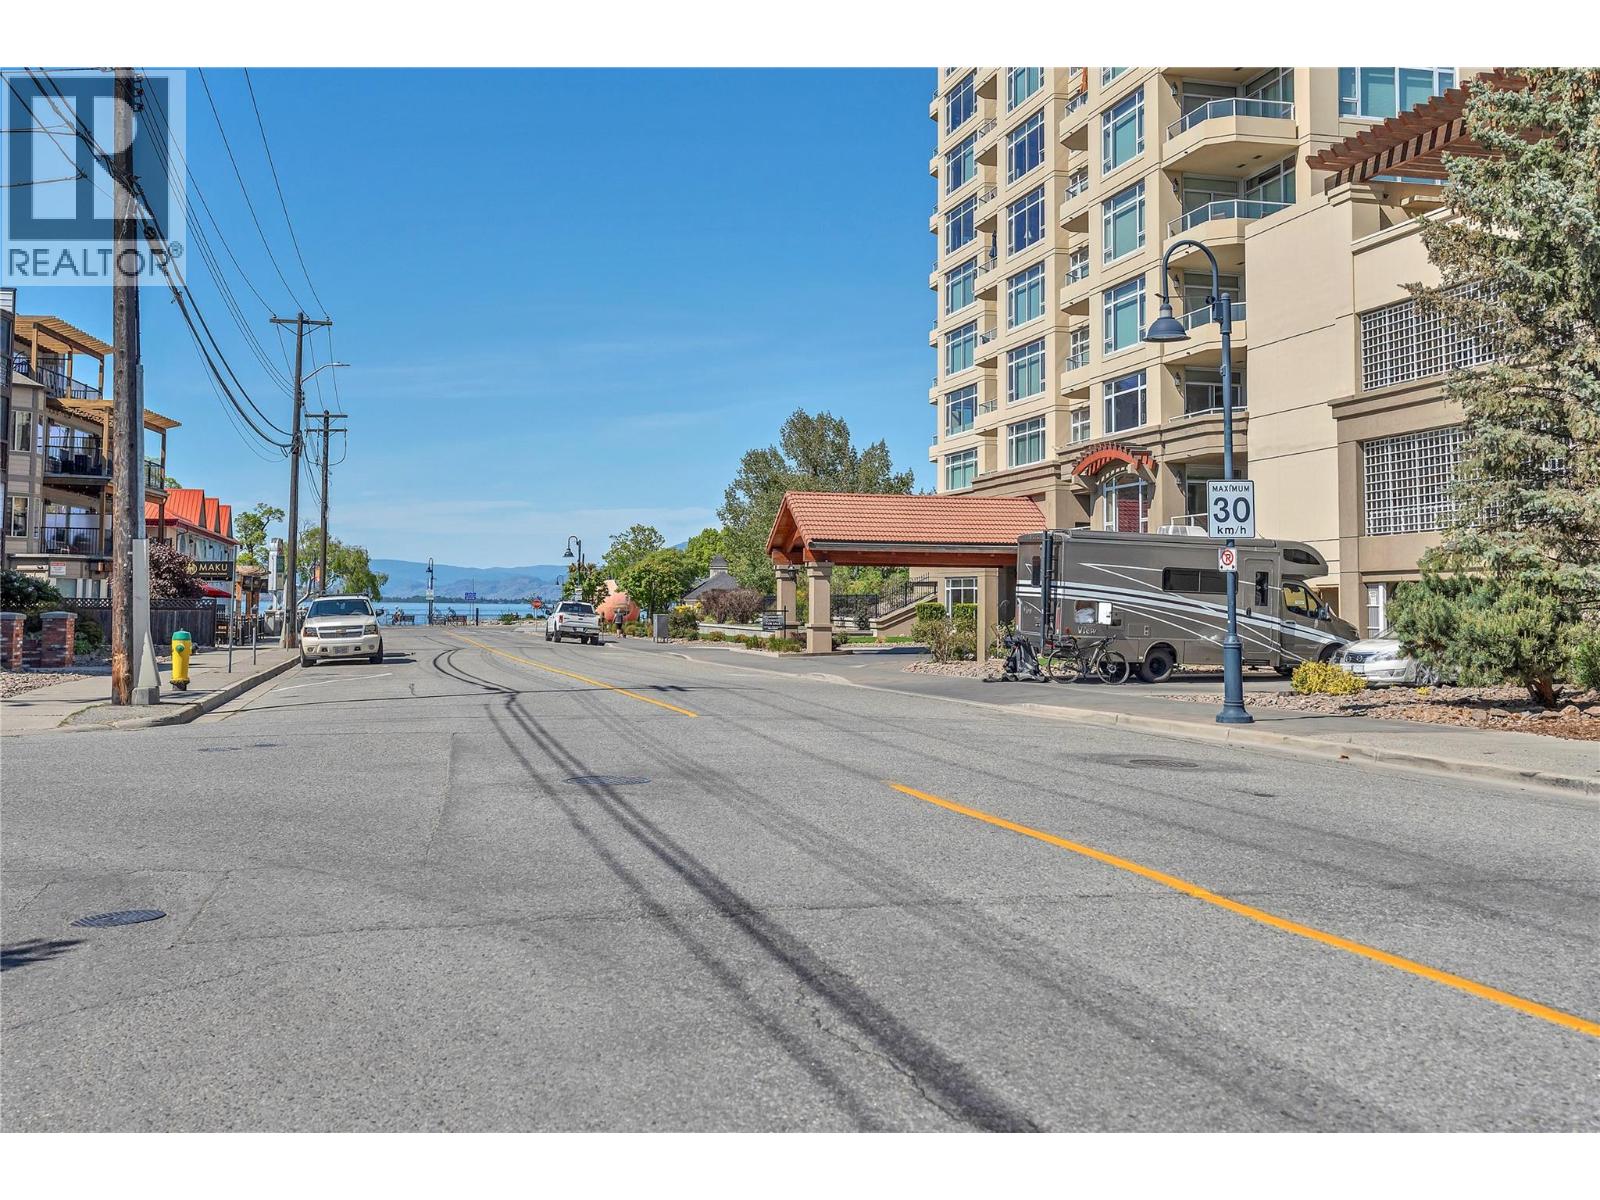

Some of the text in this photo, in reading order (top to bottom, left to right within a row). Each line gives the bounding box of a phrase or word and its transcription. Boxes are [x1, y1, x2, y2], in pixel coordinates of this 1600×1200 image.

[1213, 497, 1251, 523] 30
[1217, 526, 1247, 535] km/h
[199, 563, 228, 571] MAKU
